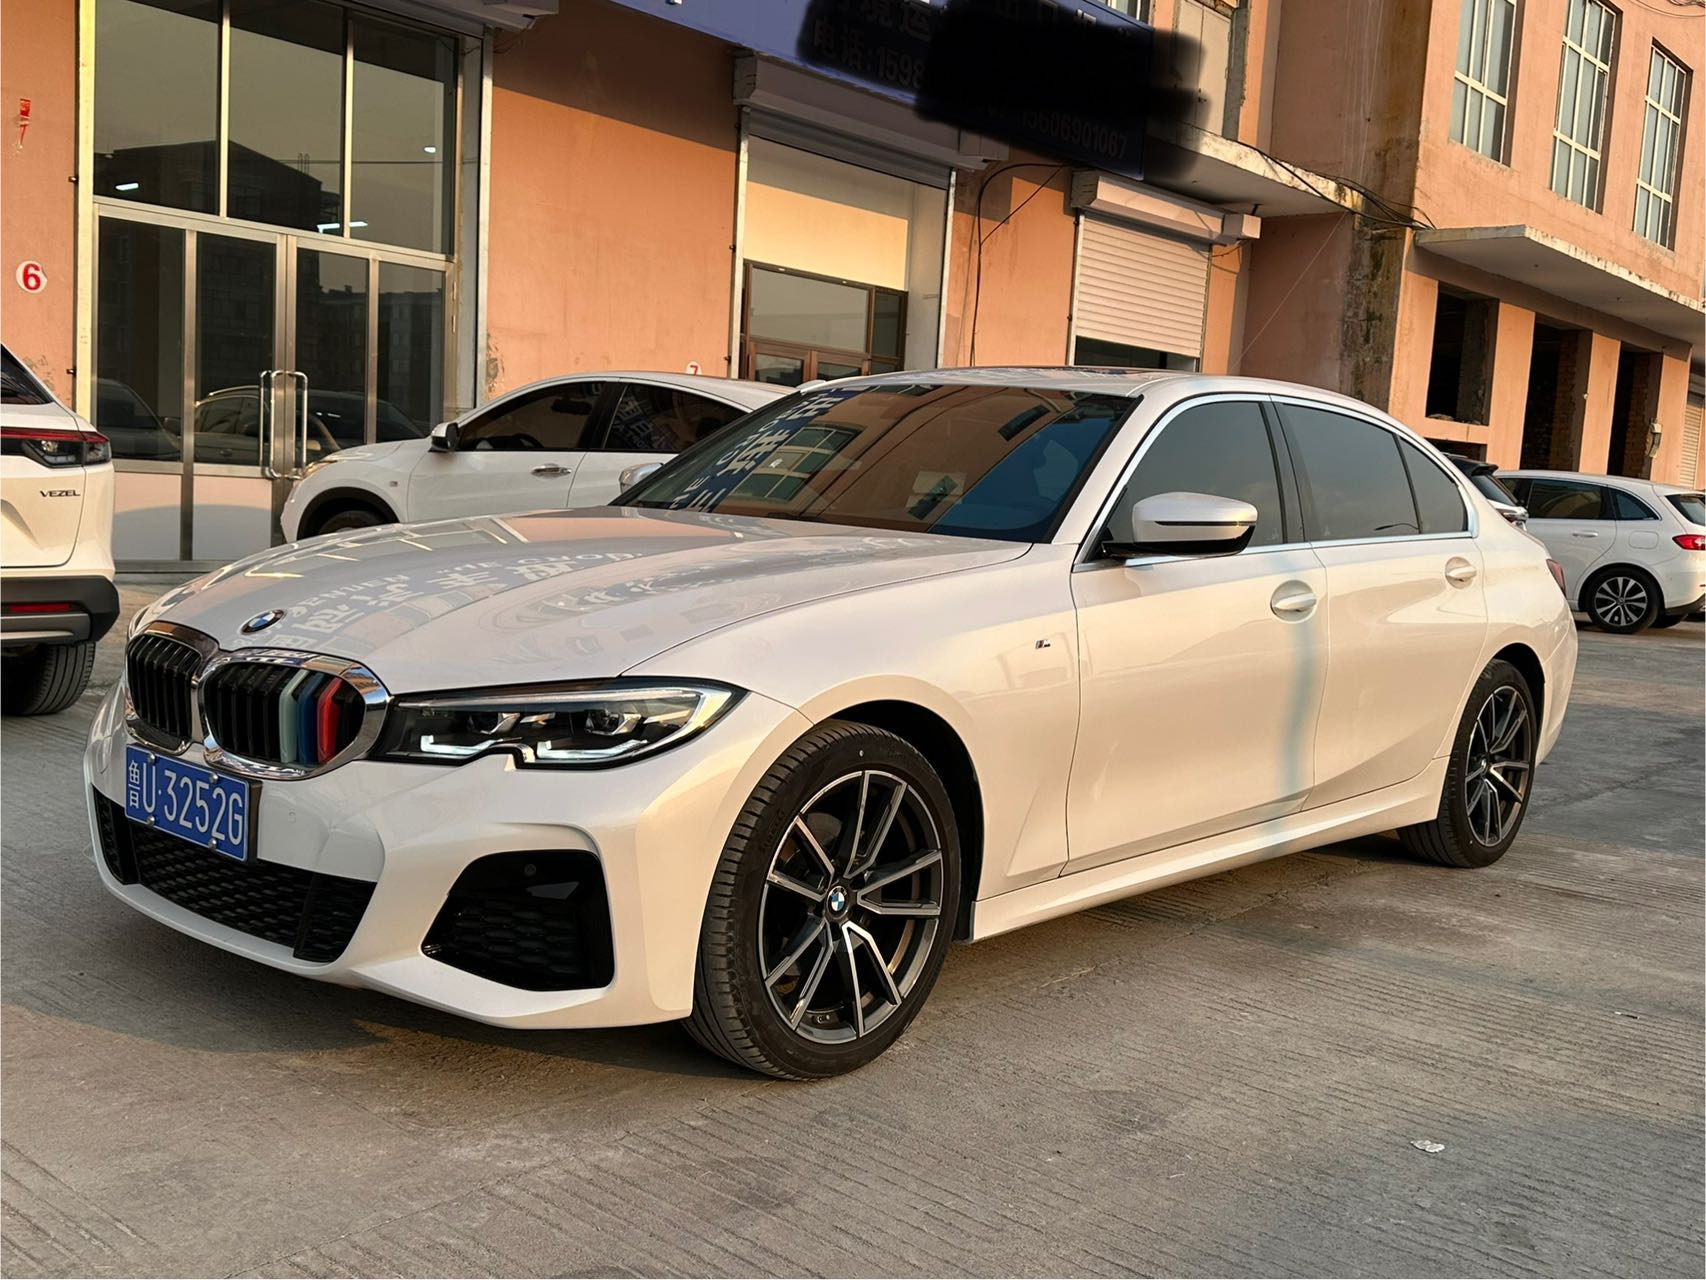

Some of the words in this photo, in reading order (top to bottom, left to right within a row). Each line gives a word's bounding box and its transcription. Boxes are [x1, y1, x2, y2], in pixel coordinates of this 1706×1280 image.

[22, 263, 41, 291] 6
[690, 364, 698, 376] 7
[39, 489, 81, 498] VEZEL
